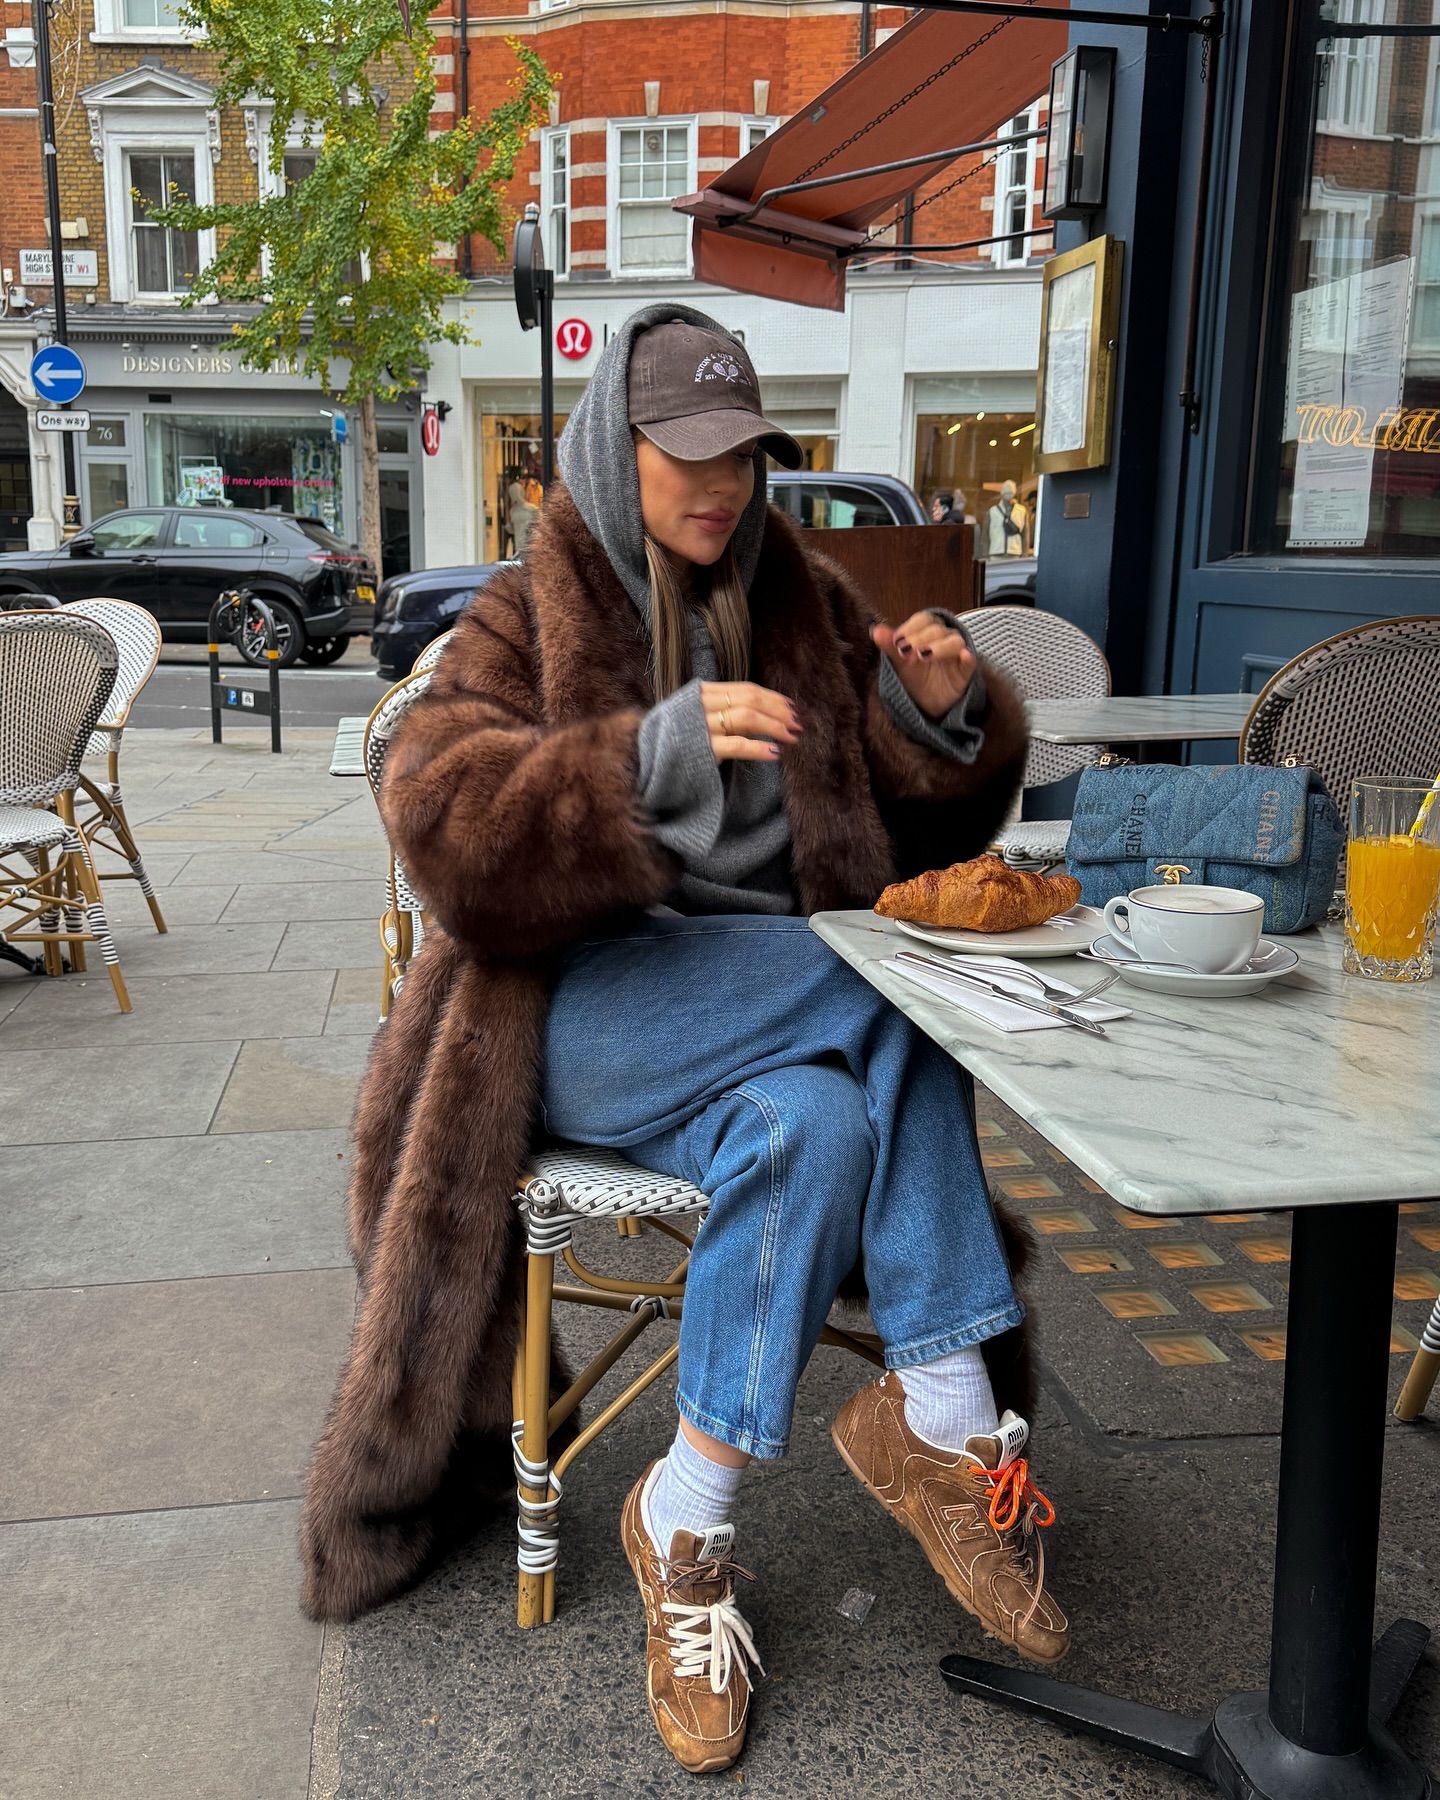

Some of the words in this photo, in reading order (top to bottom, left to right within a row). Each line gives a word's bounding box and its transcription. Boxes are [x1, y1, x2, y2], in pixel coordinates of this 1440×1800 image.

[25, 264, 43, 273] HIGH
[77, 264, 89, 273] W1
[123, 355, 233, 374] DESIGNERS
[41, 415, 61, 425] One
[66, 417, 86, 428] way
[97, 426, 113, 440] 76
[232, 478, 251, 486] new
[253, 476, 302, 489] upholstery
